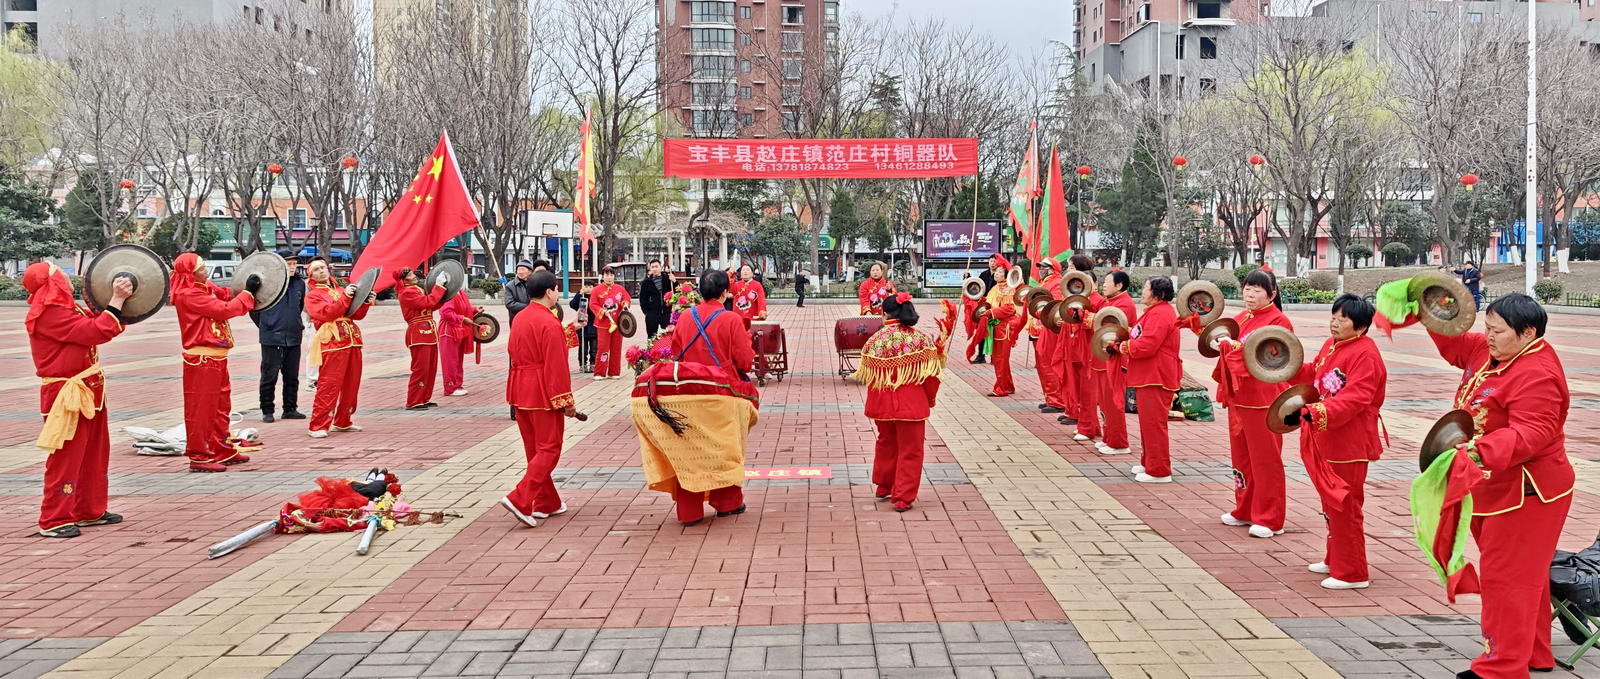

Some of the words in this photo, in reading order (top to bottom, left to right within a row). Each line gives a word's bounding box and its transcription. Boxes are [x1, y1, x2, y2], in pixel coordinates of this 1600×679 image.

[687, 143, 958, 163] 宝丰县赵庄镇范庄村铜器队
[874, 161, 955, 171] 13461288493
